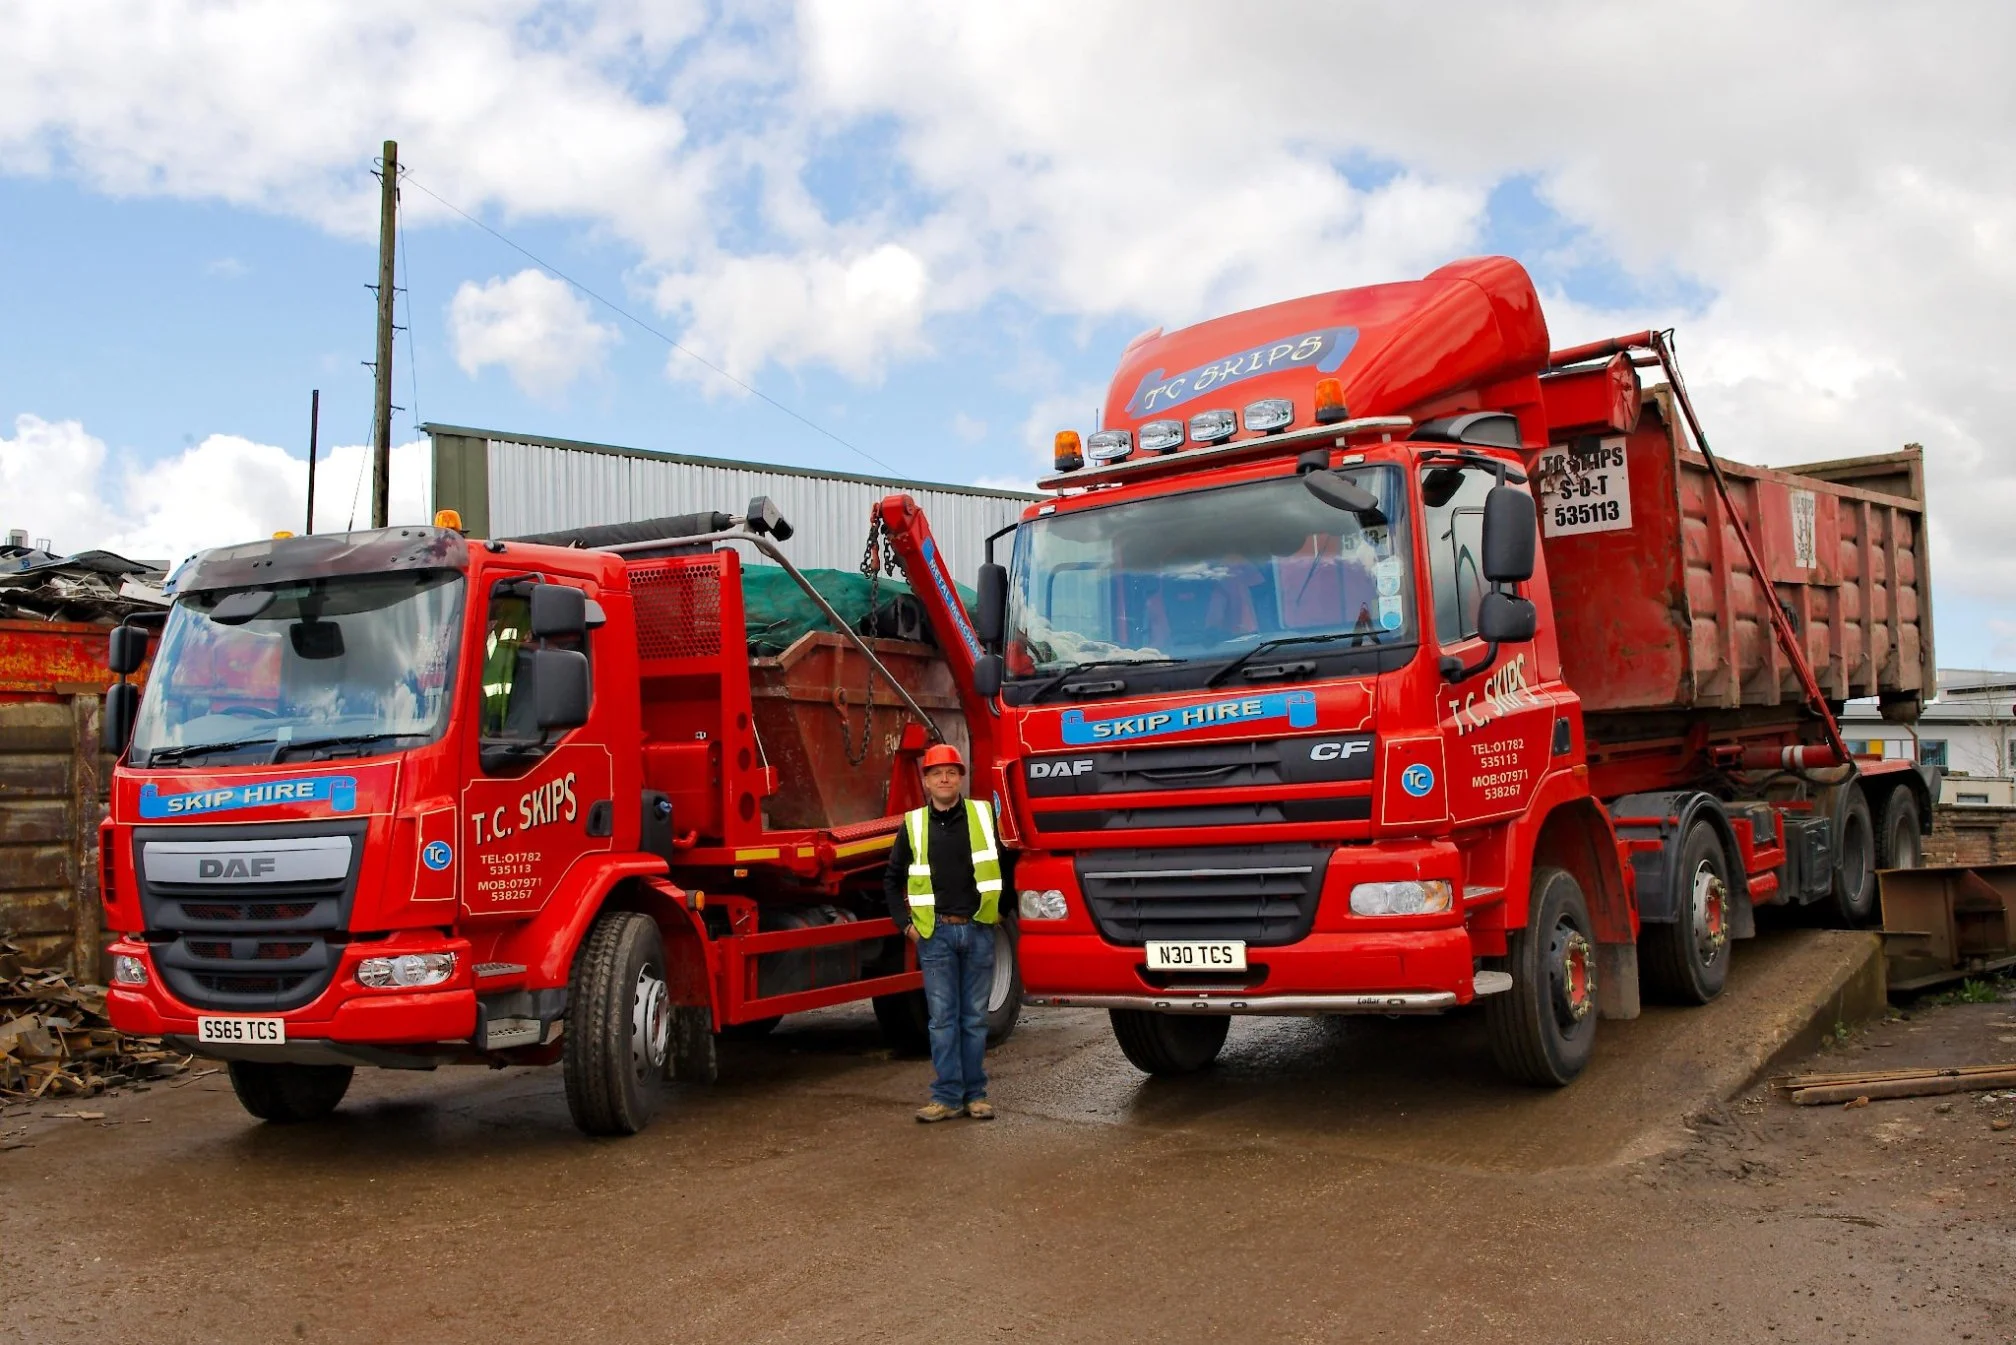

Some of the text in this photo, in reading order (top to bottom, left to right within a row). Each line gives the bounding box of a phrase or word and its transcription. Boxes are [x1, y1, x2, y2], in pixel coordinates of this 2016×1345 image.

[1144, 336, 1323, 410] TC SKIPS
[1555, 500, 1620, 527] 535113
[929, 559, 952, 601] METAL
[1449, 652, 1541, 737] T.C. SKIPS
[1092, 699, 1265, 739] SKIP HIRE
[1309, 740, 1371, 761] CF
[1029, 760, 1094, 779] DAF
[1480, 753, 1519, 769] 535113
[1405, 769, 1428, 790] TC
[1472, 769, 1529, 788] MOB:07971
[167, 782, 317, 813] SKIP HIRE
[1484, 784, 1521, 801] 538267
[471, 771, 578, 846] T.C. SKIPS
[425, 846, 446, 865] TC
[199, 857, 276, 878] DAF
[489, 864, 532, 876] 535113
[477, 877, 542, 891] MOB:07971
[491, 889, 533, 902] 538267
[1160, 945, 1233, 964] N30 TCS
[204, 1020, 278, 1040] SS65 TCS
